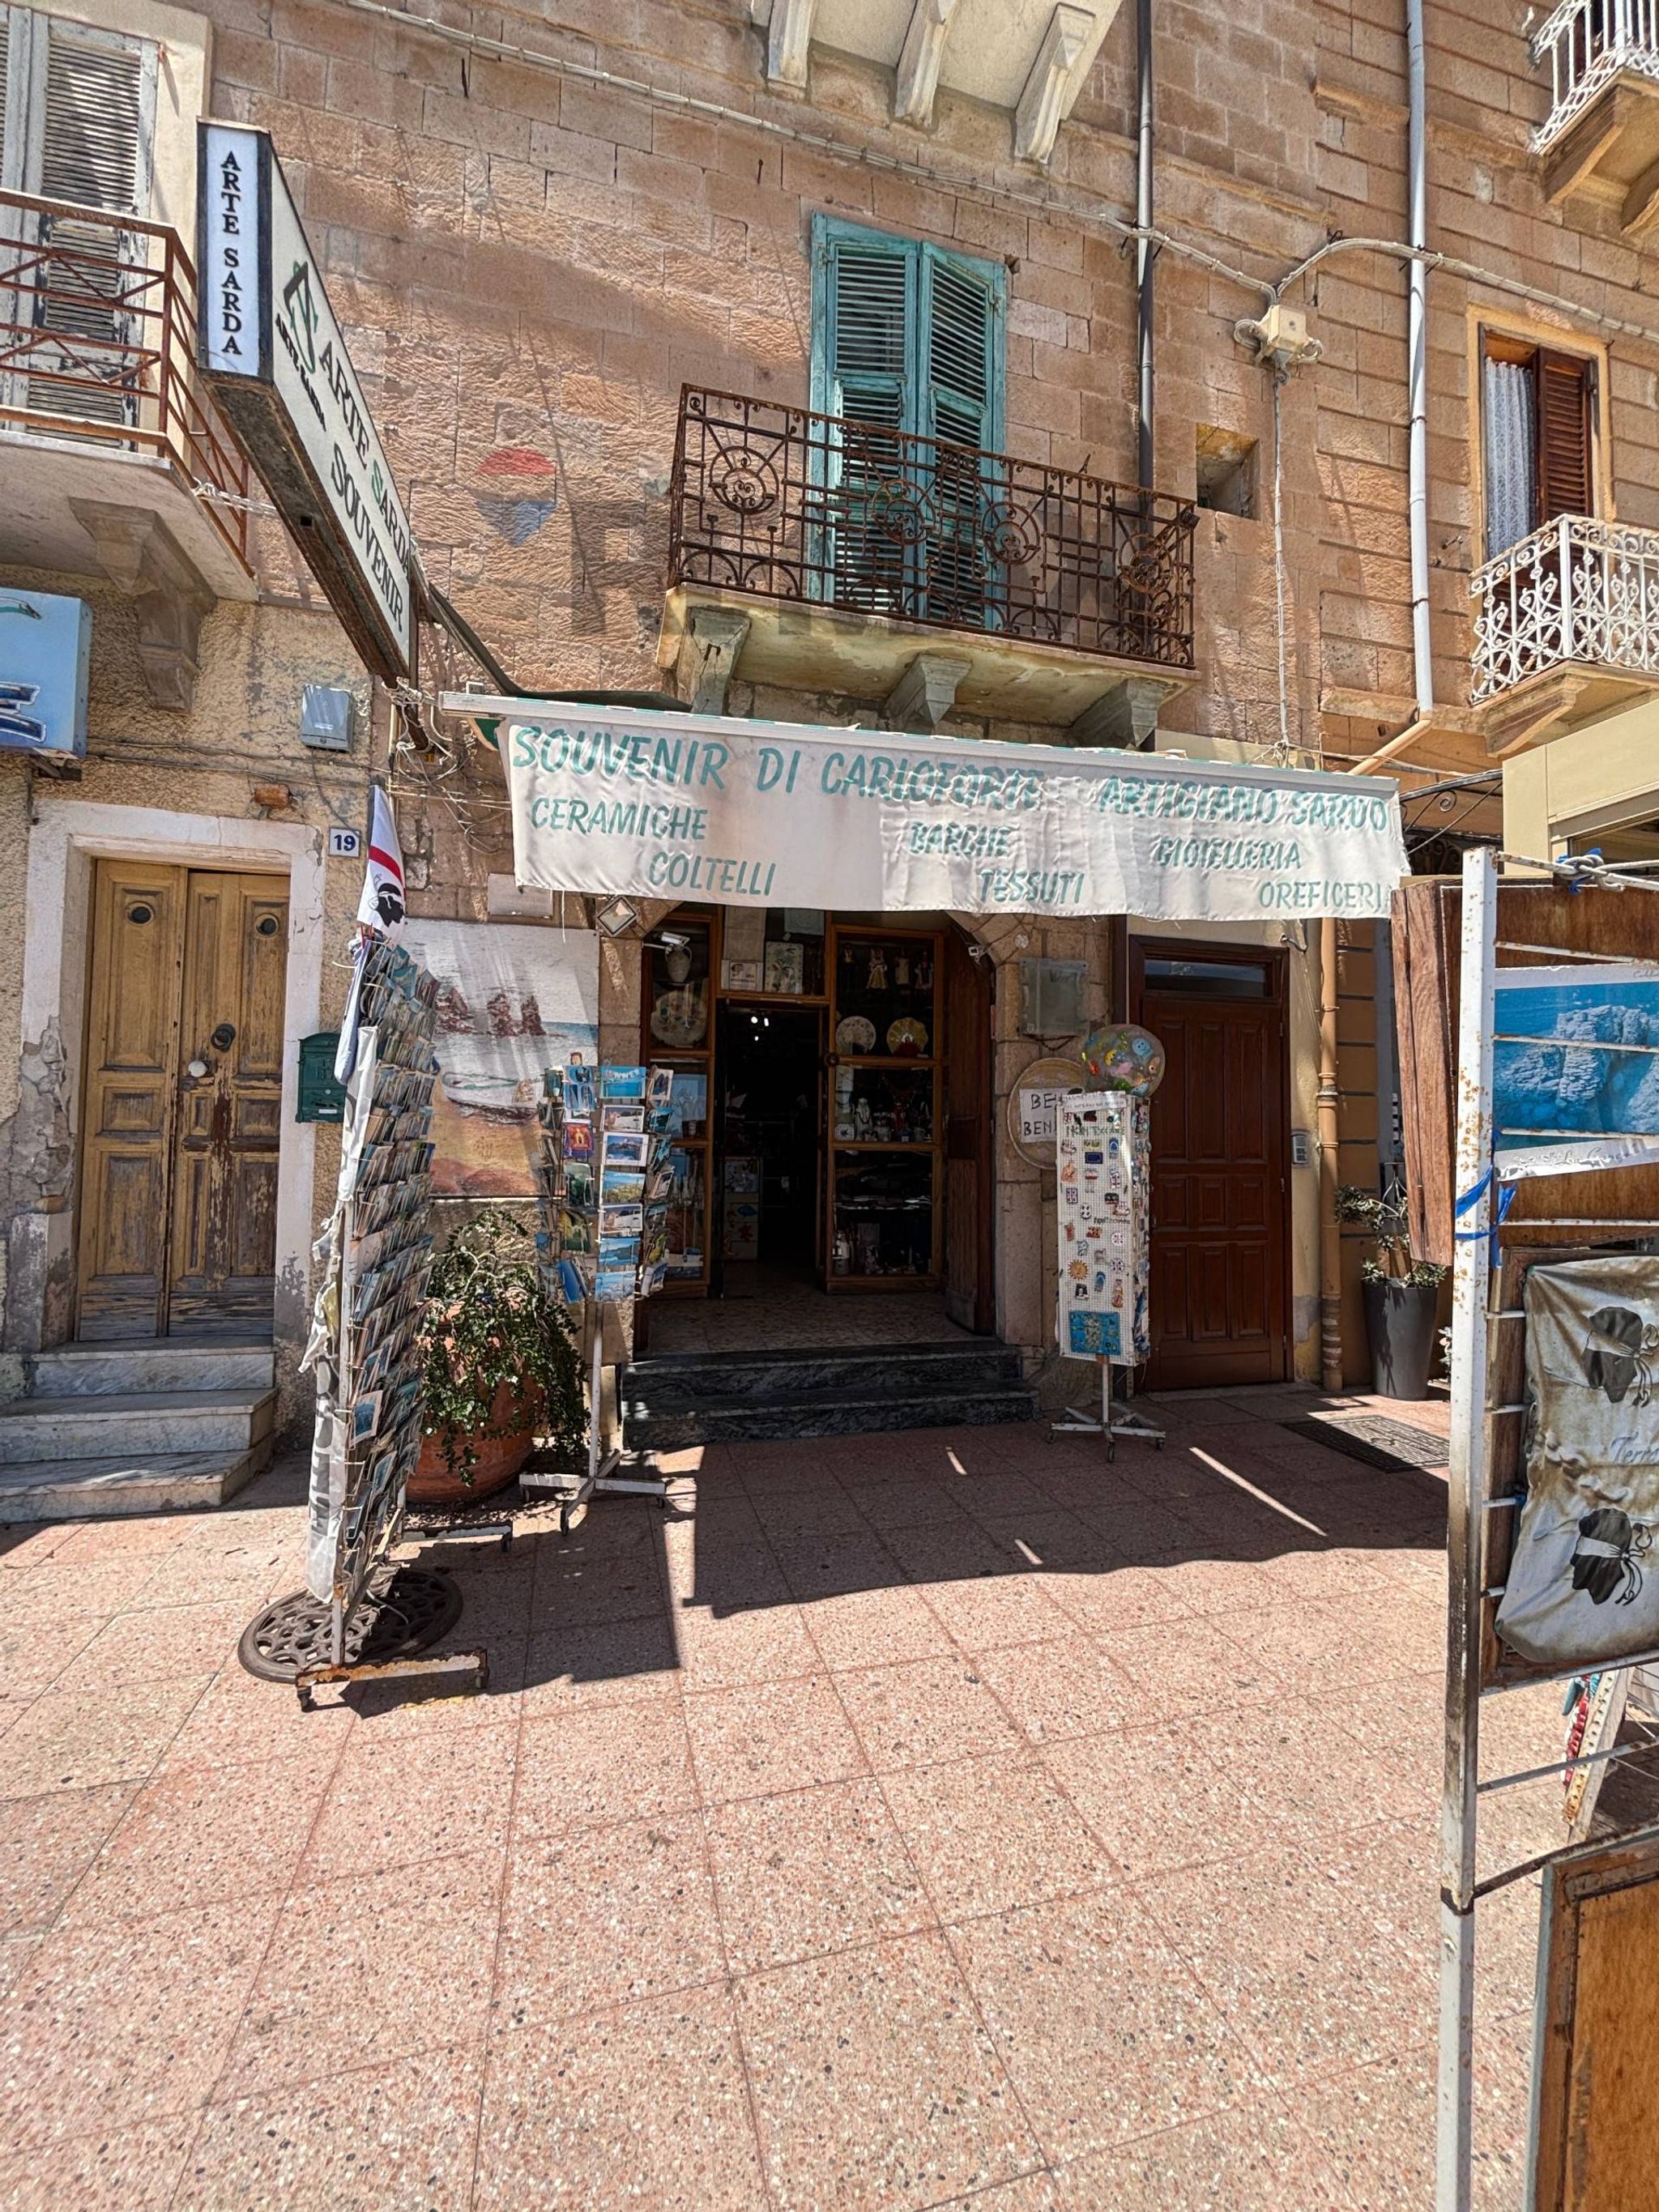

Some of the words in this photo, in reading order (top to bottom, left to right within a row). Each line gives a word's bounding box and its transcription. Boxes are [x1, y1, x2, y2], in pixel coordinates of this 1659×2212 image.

[220, 151, 242, 236] ARTE
[220, 248, 243, 355] SARDA
[318, 340, 369, 471] ARTE
[371, 459, 411, 581] SARDA
[331, 441, 403, 633] SOUVENIR
[512, 725, 729, 791] SOUVENIR
[756, 747, 802, 794] DI
[821, 752, 1046, 811] CARLOFORTE
[1098, 774, 1278, 825] ARTIGIANO
[1290, 790, 1388, 832] SARDO
[334, 833, 356, 851] 19
[531, 797, 709, 842] CERAMICHE
[910, 820, 1014, 856] BARCHE
[1156, 837, 1303, 871] GIOIELLERIA
[648, 850, 776, 897] COLTELLI
[979, 869, 1085, 904] TESSUTI
